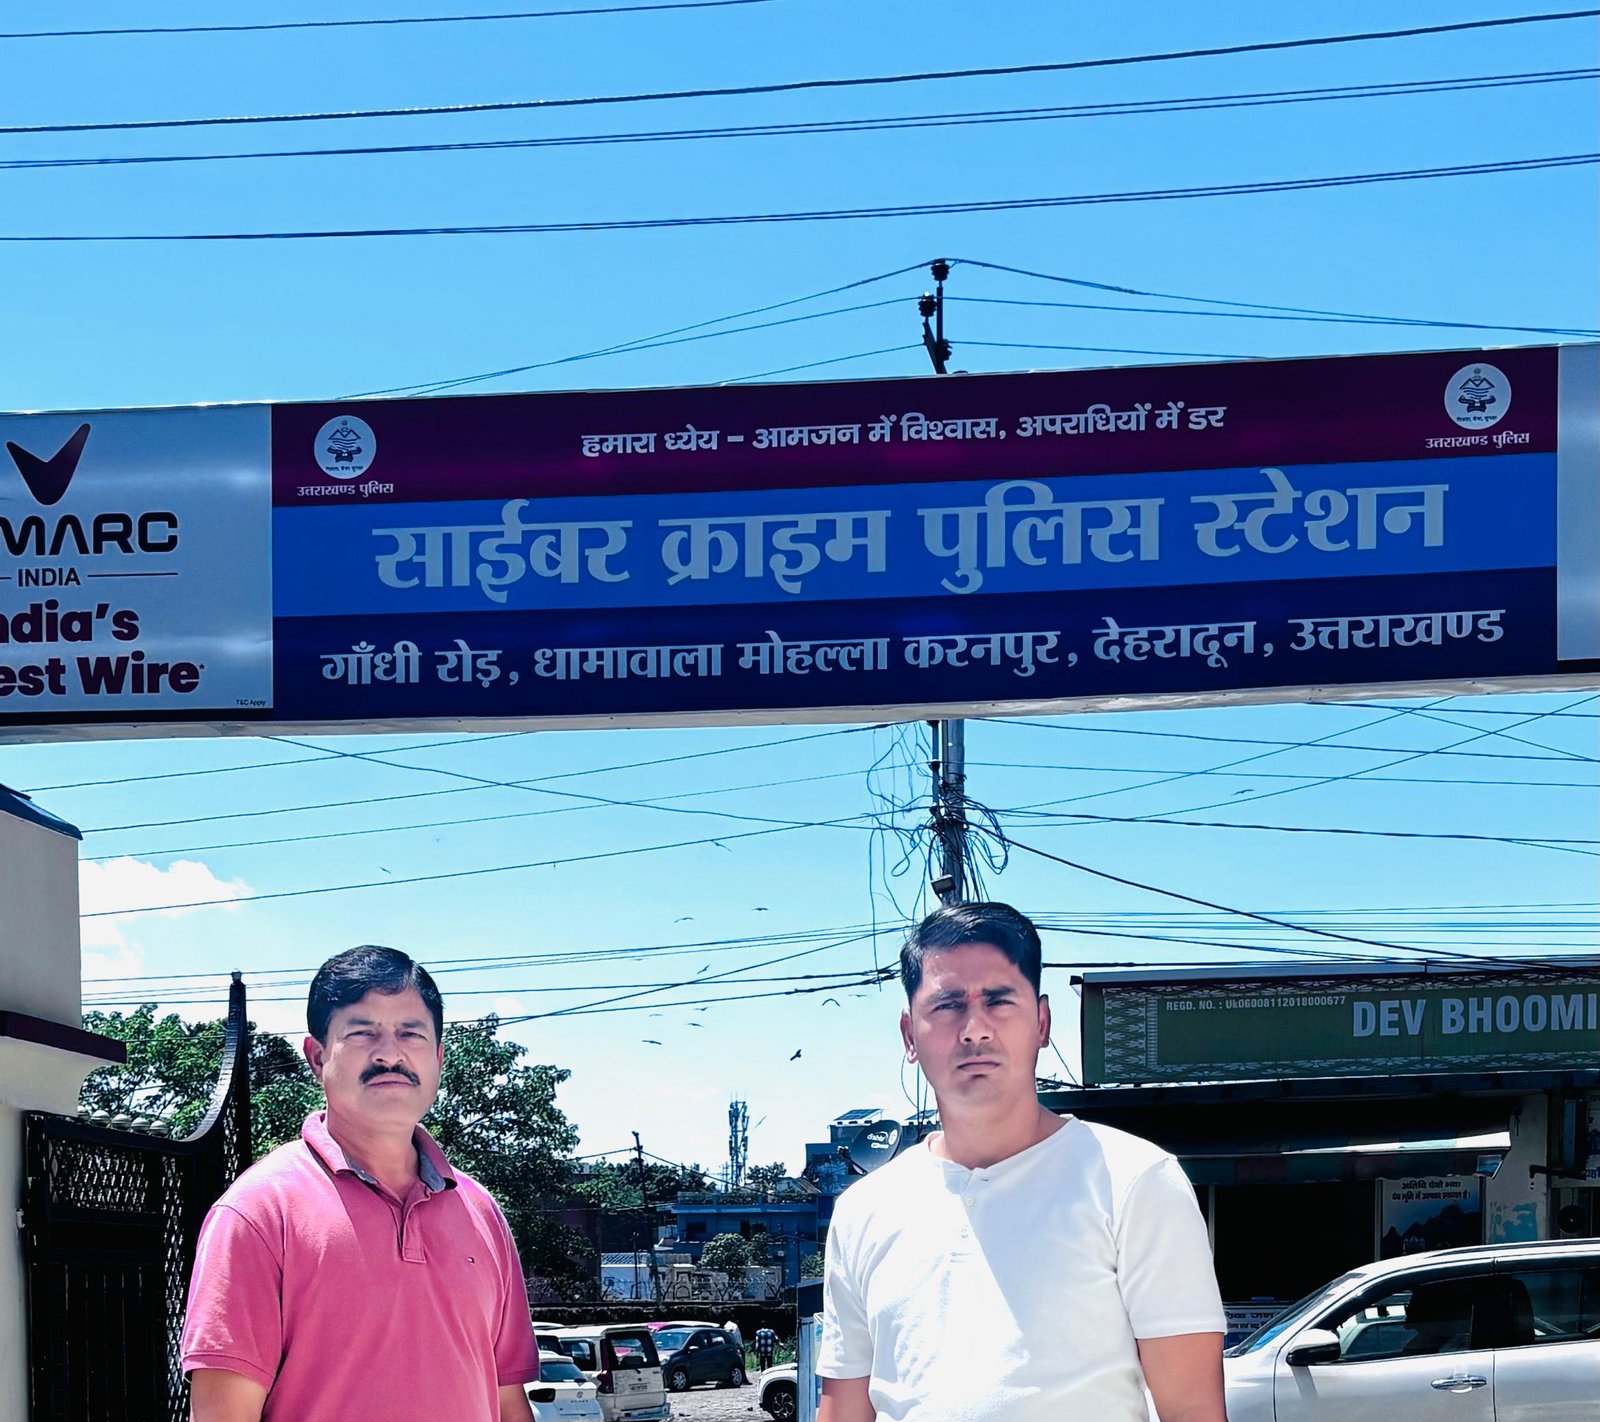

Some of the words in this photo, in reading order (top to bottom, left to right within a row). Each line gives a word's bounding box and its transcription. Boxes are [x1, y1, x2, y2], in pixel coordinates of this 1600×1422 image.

[581, 432, 657, 457] हमारा
[664, 424, 720, 451] ध्येय
[752, 424, 861, 449] आमजन
[868, 414, 897, 442] में
[900, 412, 1006, 441] विश्वास,
[1016, 403, 1151, 437] अपराधियों
[1155, 401, 1184, 429] में
[1188, 406, 1227, 429] डर
[1425, 435, 1488, 448] उत्तराखण्ड
[1492, 431, 1530, 448] पुलिस
[297, 485, 355, 496] उत्तराखण्ड
[359, 480, 394, 498] पुलिस
[372, 499, 632, 603] साईबर
[659, 509, 891, 593] क्राइम
[917, 480, 1164, 594] पुलिस
[1191, 468, 1449, 556] स्टेशन
[18, 567, 81, 587] INDIA
[0, 599, 140, 643] dia's
[320, 640, 422, 685] गाँधी
[534, 644, 724, 680] धामावाला
[736, 630, 890, 675] मोहल्ला
[903, 631, 1077, 677] करनपुर,
[1092, 617, 1273, 668] देहरादून,
[1288, 609, 1506, 651] उत्तराखण्ड
[1166, 1001, 1196, 1011] REGD.
[1199, 999, 1216, 1010] NO.
[1353, 1000, 1426, 1037] DEV
[1441, 993, 1597, 1035] BHOOMI
